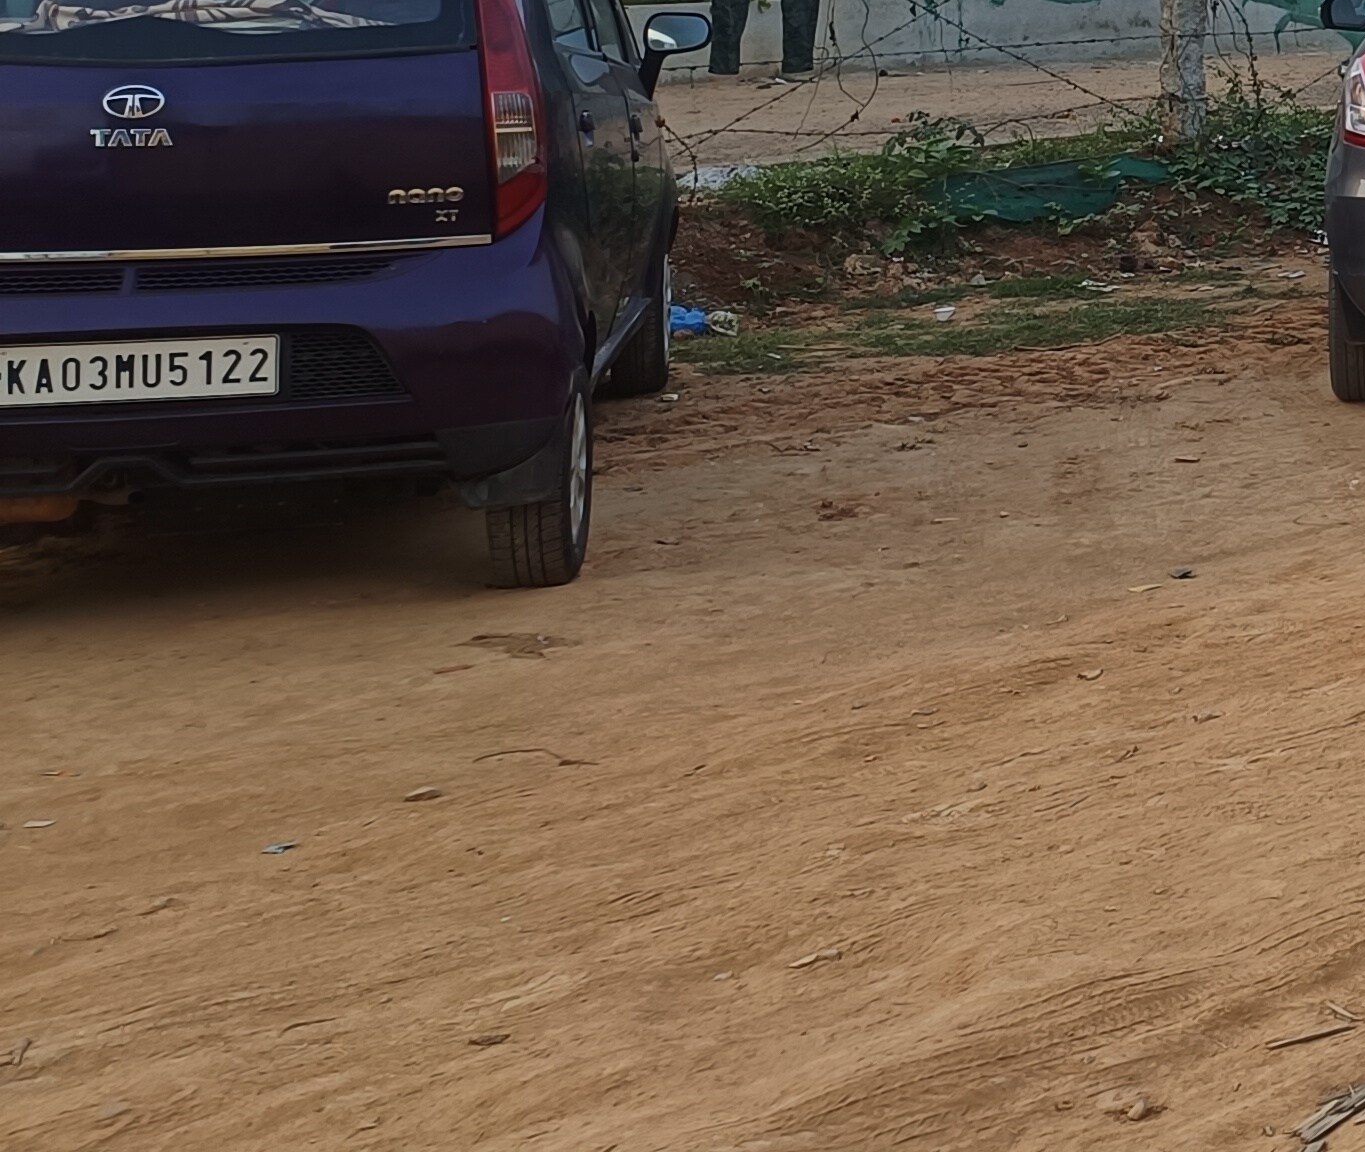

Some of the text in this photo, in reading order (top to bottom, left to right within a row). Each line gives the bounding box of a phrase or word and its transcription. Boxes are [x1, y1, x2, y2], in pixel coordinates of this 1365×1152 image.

[89, 128, 174, 147] TATA
[387, 186, 464, 204] nano
[435, 209, 459, 222] XT
[7, 348, 268, 395] KA03MU5122
